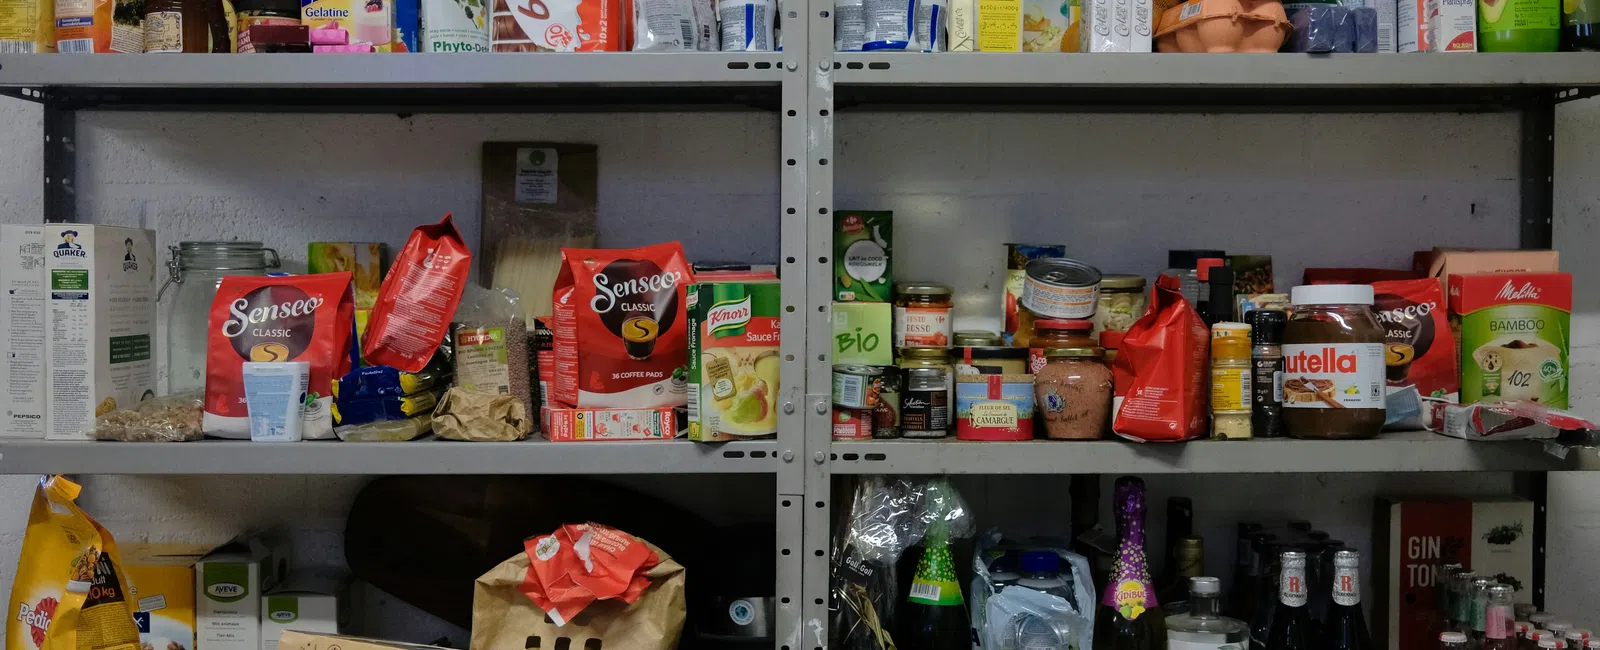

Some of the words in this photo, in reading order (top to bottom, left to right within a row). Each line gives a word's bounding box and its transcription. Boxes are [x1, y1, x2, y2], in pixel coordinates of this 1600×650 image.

[305, 7, 349, 17] Gelatine
[53, 250, 86, 258] QUAKER
[122, 261, 139, 272] QUAKER
[590, 271, 681, 313] Senseo
[1495, 280, 1539, 300] Melitta
[621, 303, 656, 312] CLASSIC
[709, 307, 750, 325] Knorr
[1375, 301, 1437, 323] nseo
[222, 295, 323, 338] Senseo
[252, 328, 291, 338] CLASSIC
[1385, 330, 1413, 338] ASSIC
[1490, 320, 1545, 331] BAMBOO
[747, 332, 772, 342] Sauce
[1280, 348, 1357, 373] nutella
[612, 372, 620, 380] 36
[620, 372, 645, 380] COFFEE
[1508, 370, 1532, 388] 102
[663, 411, 672, 437] Royco
[976, 416, 1014, 425] CAMARGUE
[1408, 535, 1441, 560] GIN
[1289, 576, 1300, 593] R
[1341, 575, 1352, 592] R
[102, 587, 116, 598] kg
[17, 602, 51, 628] Pedi
